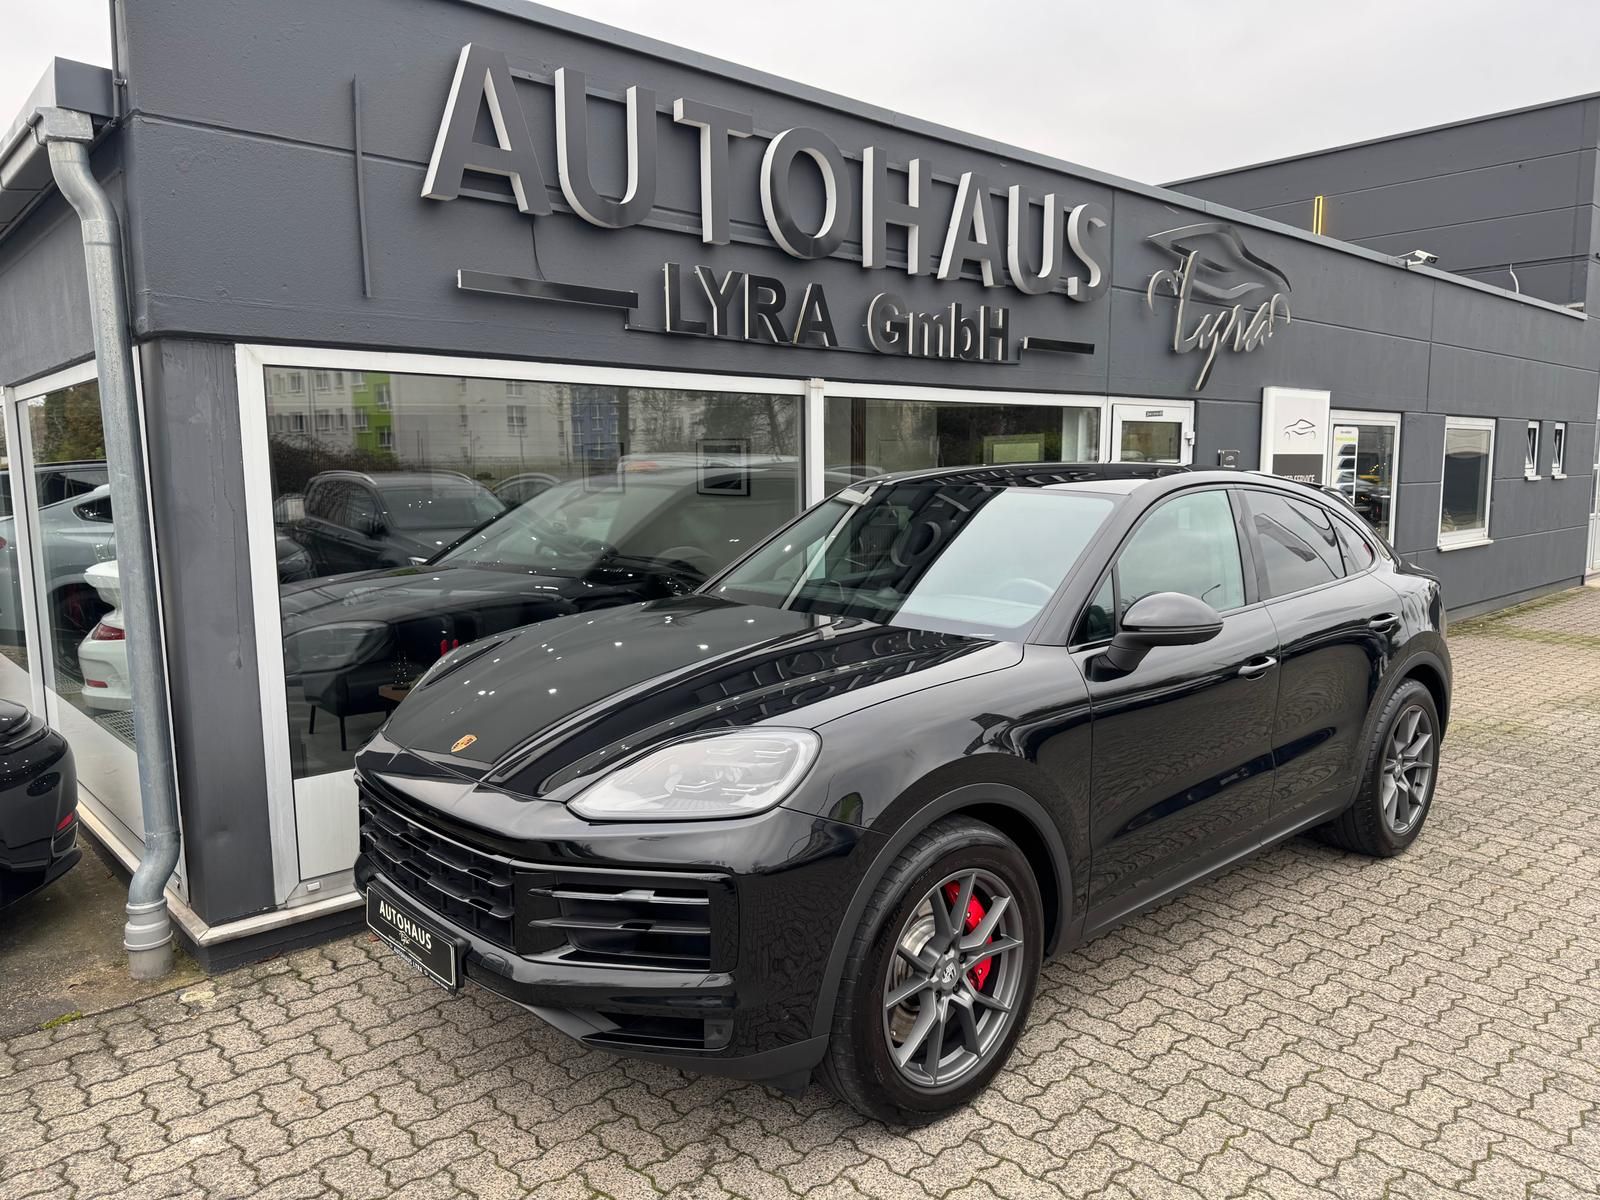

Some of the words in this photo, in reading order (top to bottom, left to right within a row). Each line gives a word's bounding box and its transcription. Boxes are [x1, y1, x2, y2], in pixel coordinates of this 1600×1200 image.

[420, 41, 1110, 303] AUTOHAUS
[663, 261, 838, 348] LYRA
[866, 290, 1012, 362] GmbH
[1148, 249, 1292, 392] Lyra
[379, 900, 432, 950] AUTOHAUS
